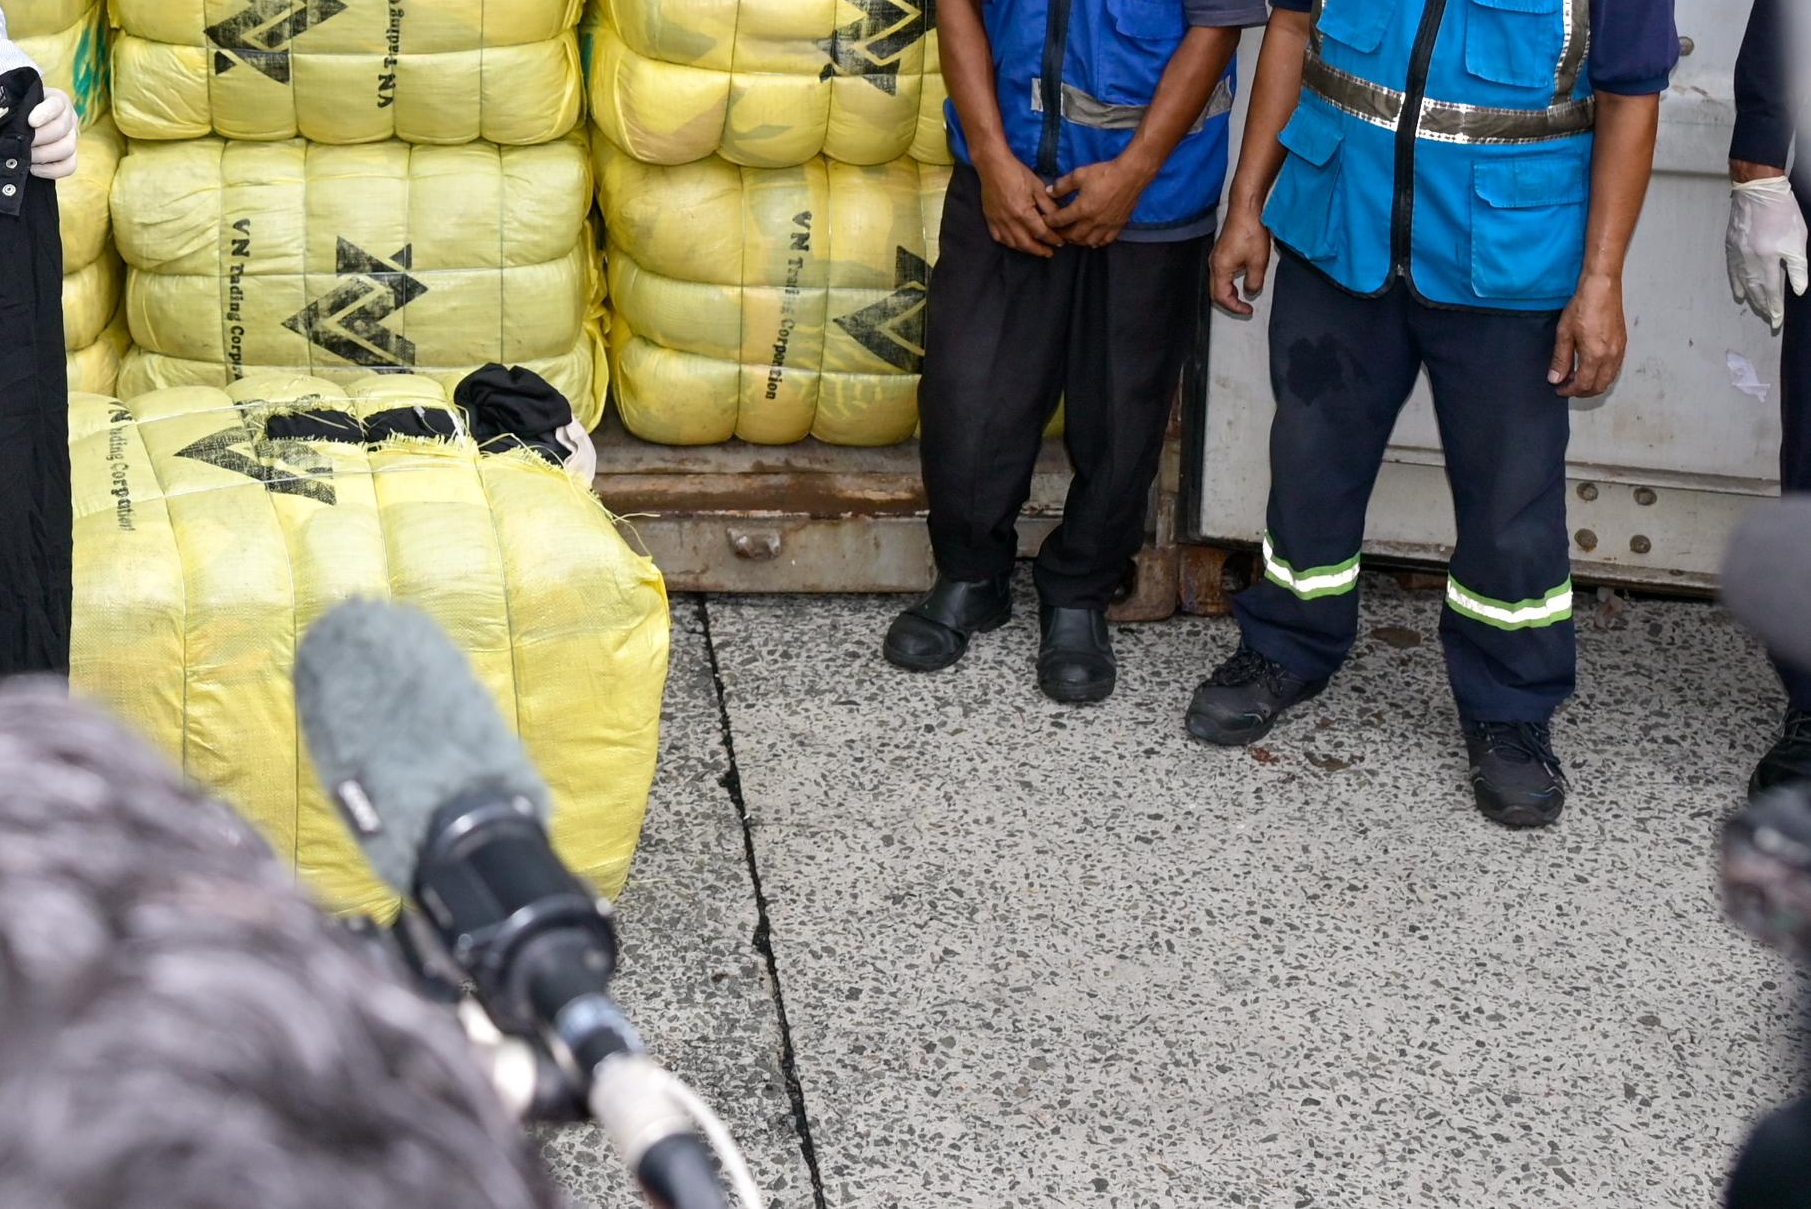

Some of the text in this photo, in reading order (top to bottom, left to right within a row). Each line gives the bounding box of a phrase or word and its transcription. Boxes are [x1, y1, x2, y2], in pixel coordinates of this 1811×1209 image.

[383, 9, 405, 69] Tading
[377, 73, 397, 109] VN
[231, 218, 251, 258] VN
[789, 210, 813, 253] VN
[227, 263, 245, 322] Tading
[765, 318, 796, 401] Corportion
